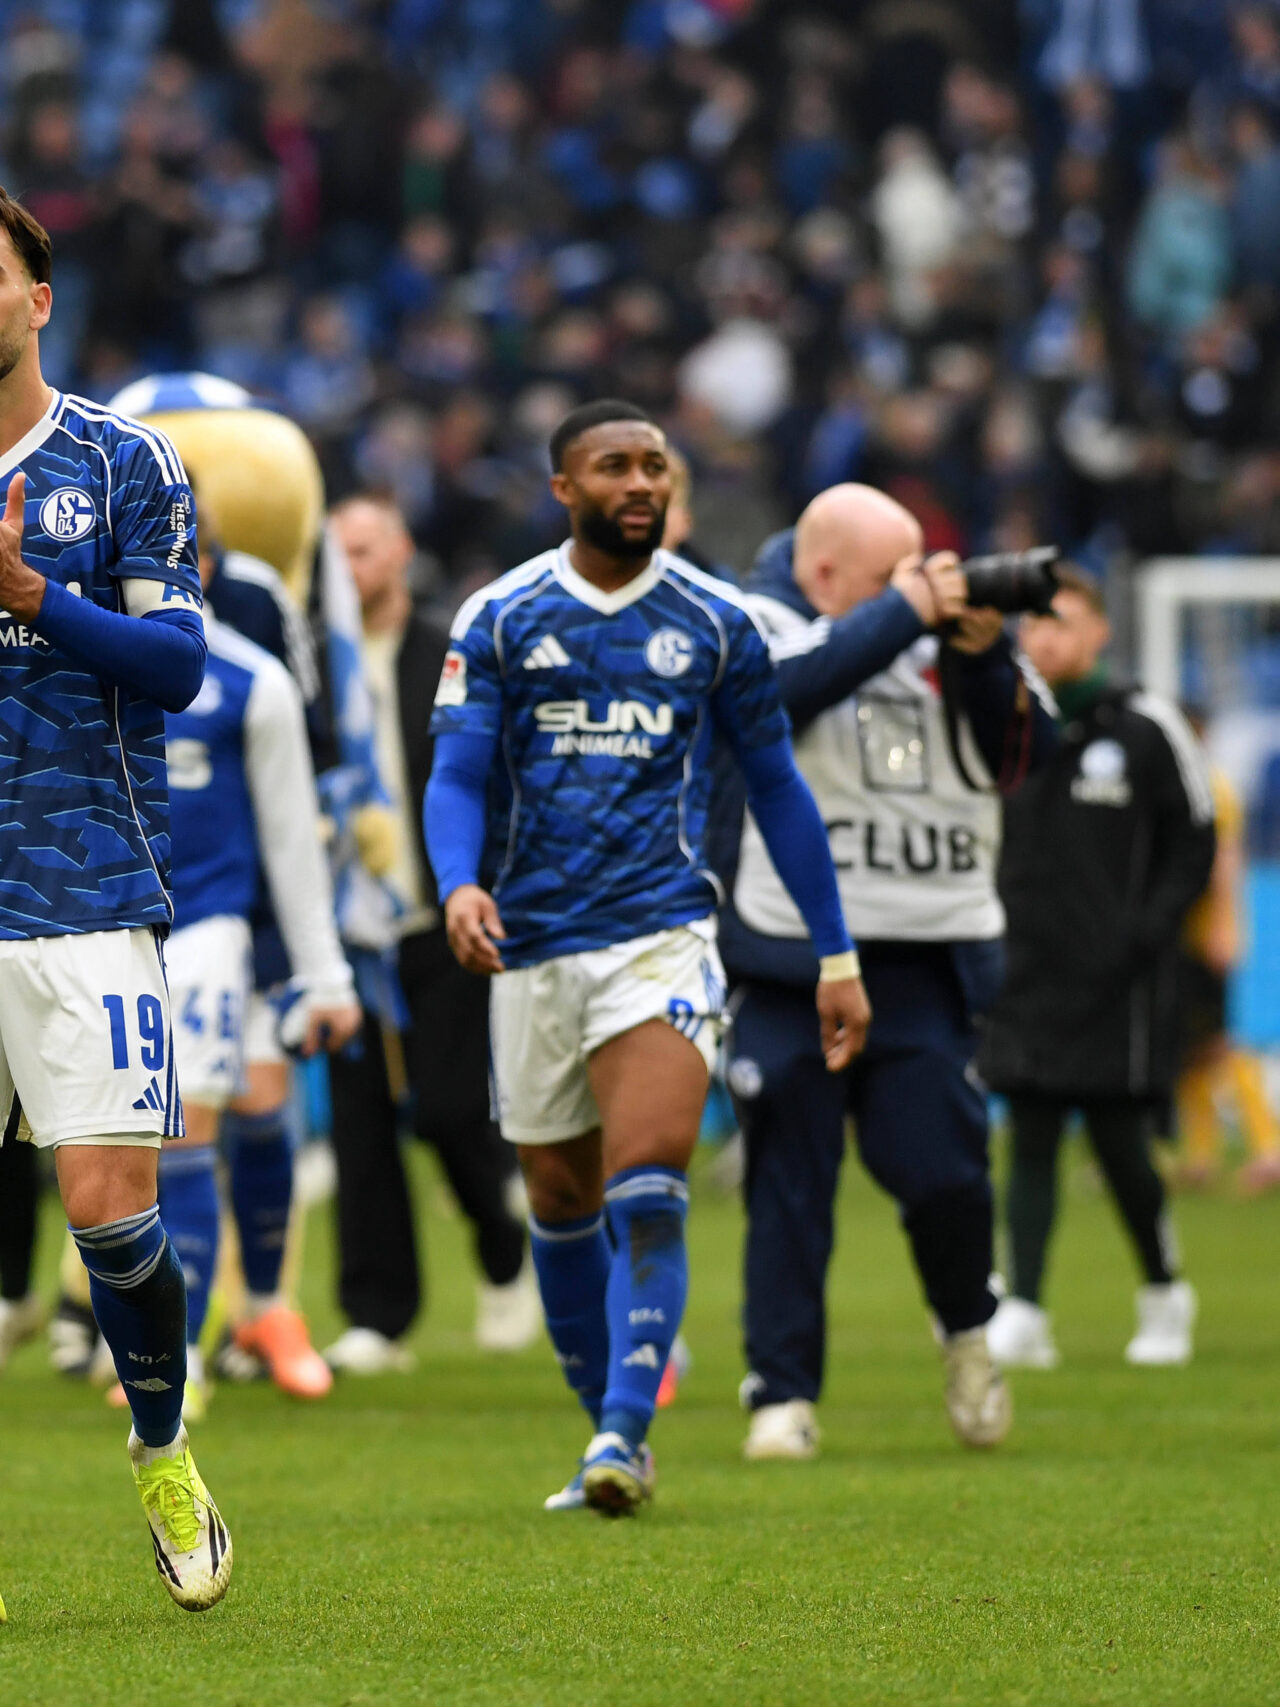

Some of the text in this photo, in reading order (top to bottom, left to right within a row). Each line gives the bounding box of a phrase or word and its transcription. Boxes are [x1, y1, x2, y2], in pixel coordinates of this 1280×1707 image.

[162, 583, 202, 609] A
[534, 699, 674, 735] SUN
[826, 819, 978, 873] CLUB
[102, 994, 164, 1071] 19
